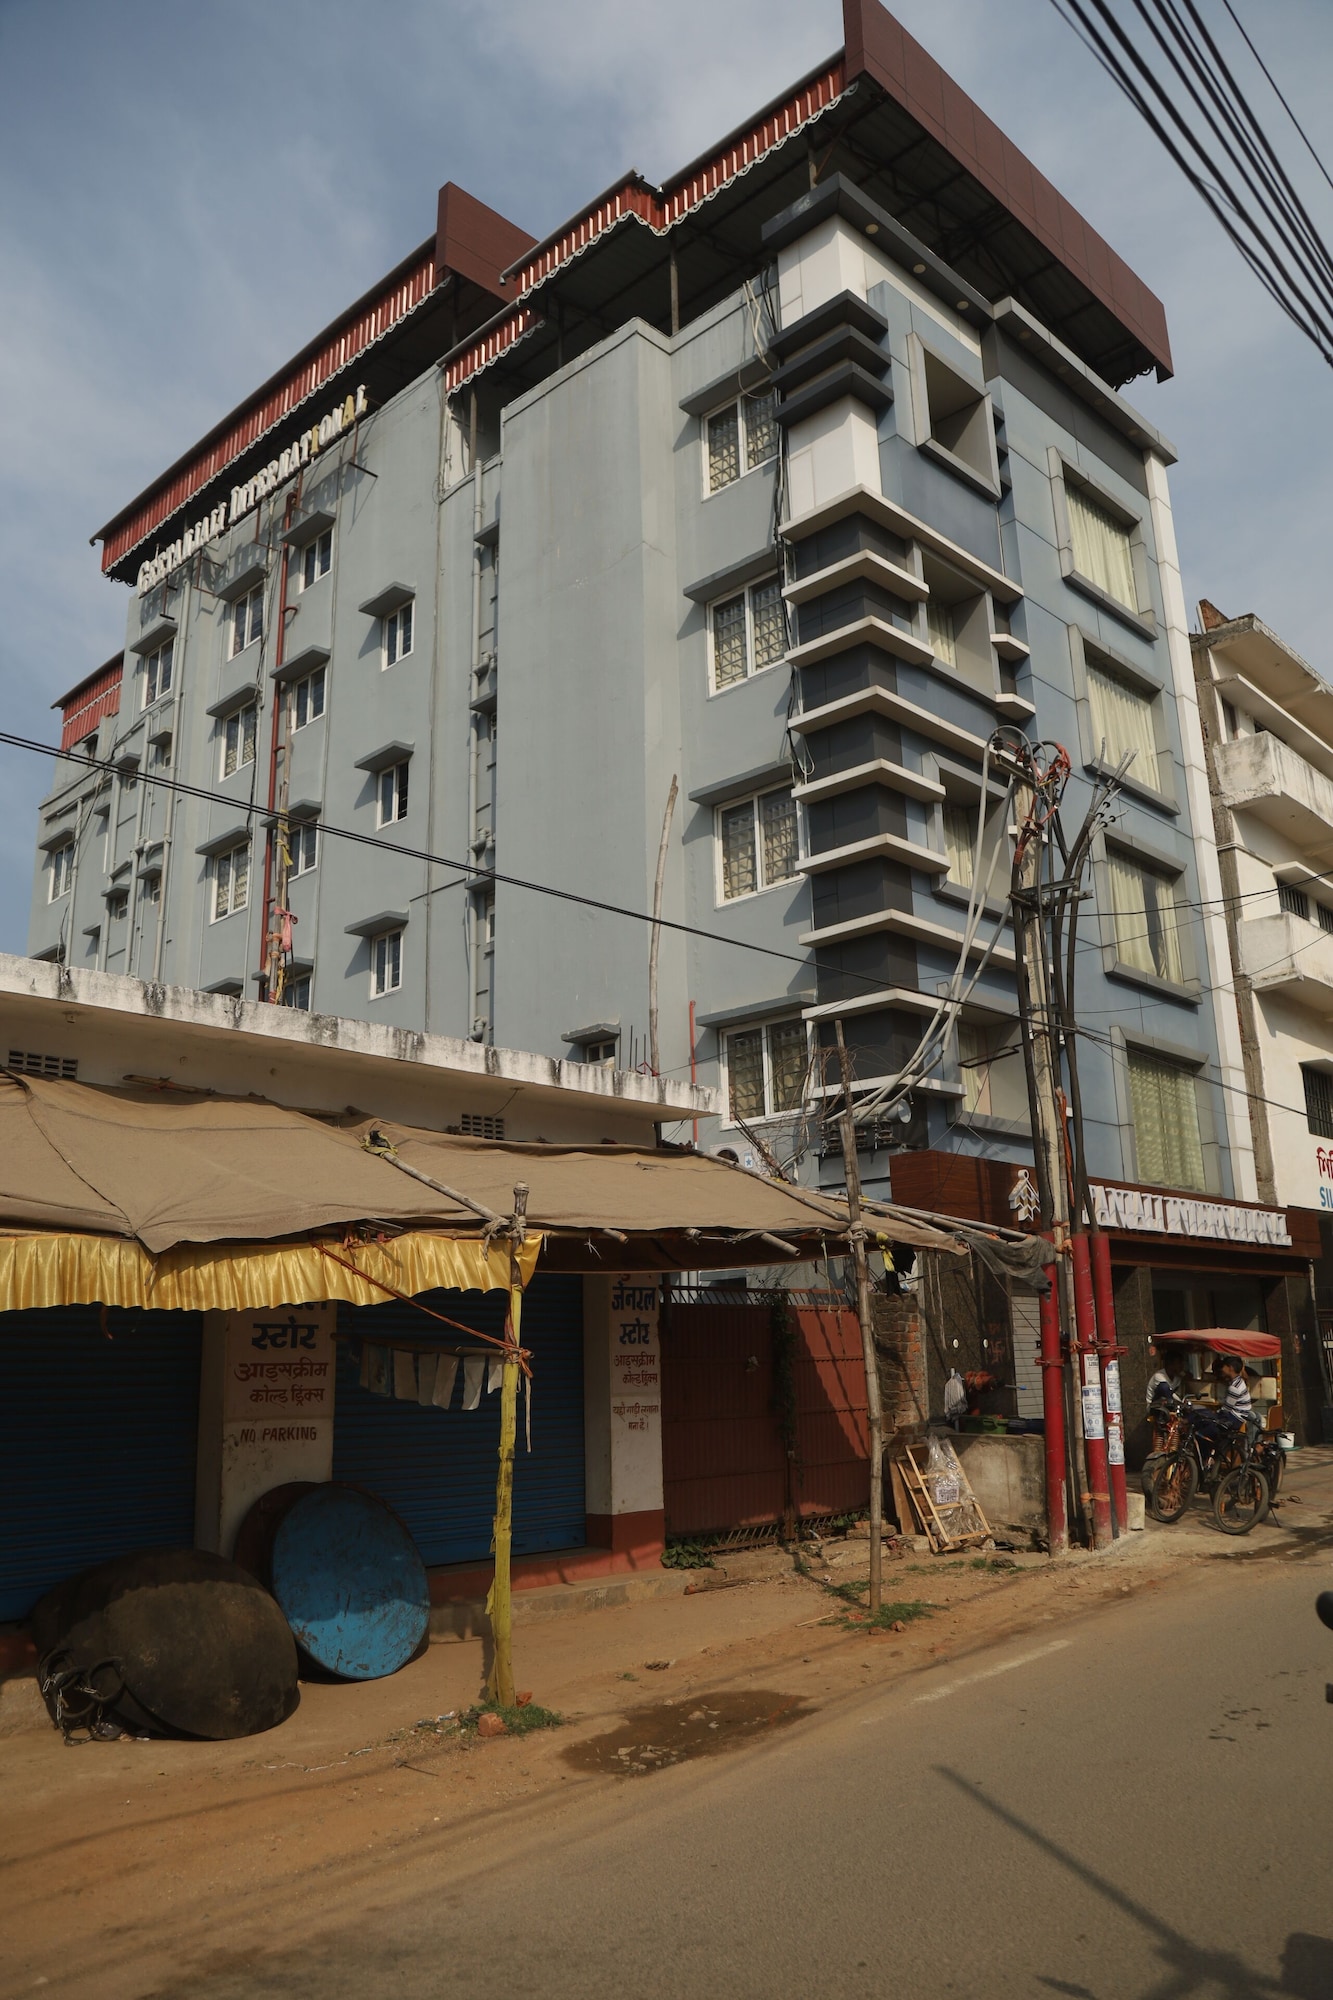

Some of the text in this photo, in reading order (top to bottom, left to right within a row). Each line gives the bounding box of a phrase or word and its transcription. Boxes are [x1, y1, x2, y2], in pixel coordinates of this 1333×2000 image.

[228, 384, 368, 525] INTERNATIONAL
[251, 1315, 319, 1350] स्टोर
[619, 1317, 650, 1345] स्टोर
[234, 1357, 329, 1382] आइसक्रीम
[249, 1384, 289, 1408] कोल्ड
[240, 1426, 317, 1443] NO PARKING
